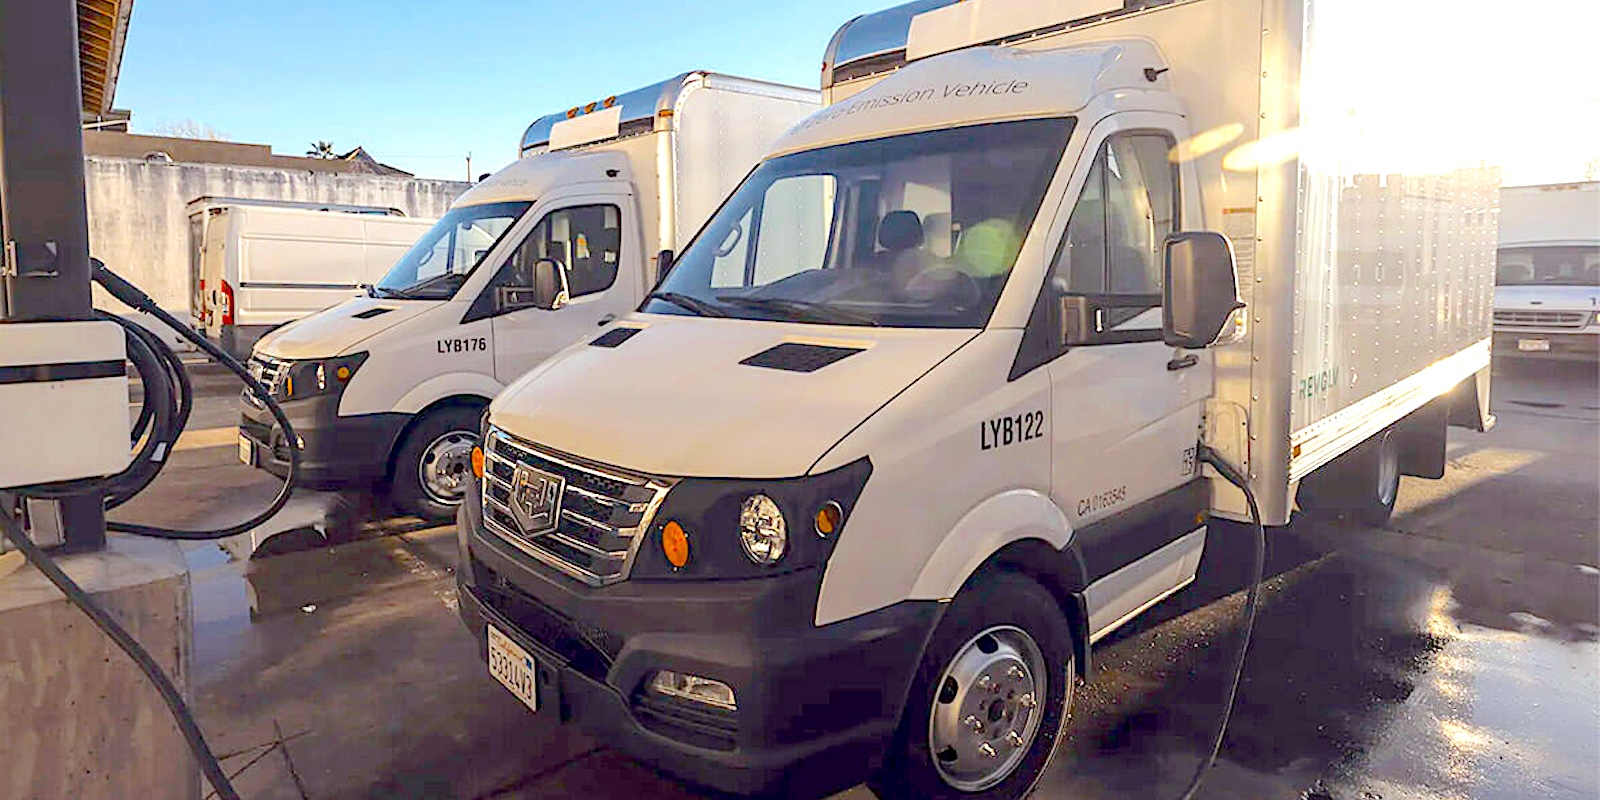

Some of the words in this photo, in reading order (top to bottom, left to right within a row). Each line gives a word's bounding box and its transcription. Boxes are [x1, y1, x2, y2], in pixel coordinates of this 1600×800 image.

[943, 78, 1029, 98] Vehicle
[437, 337, 487, 354] LYB176
[981, 410, 1044, 450] LYB122
[1077, 498, 1091, 517] CA
